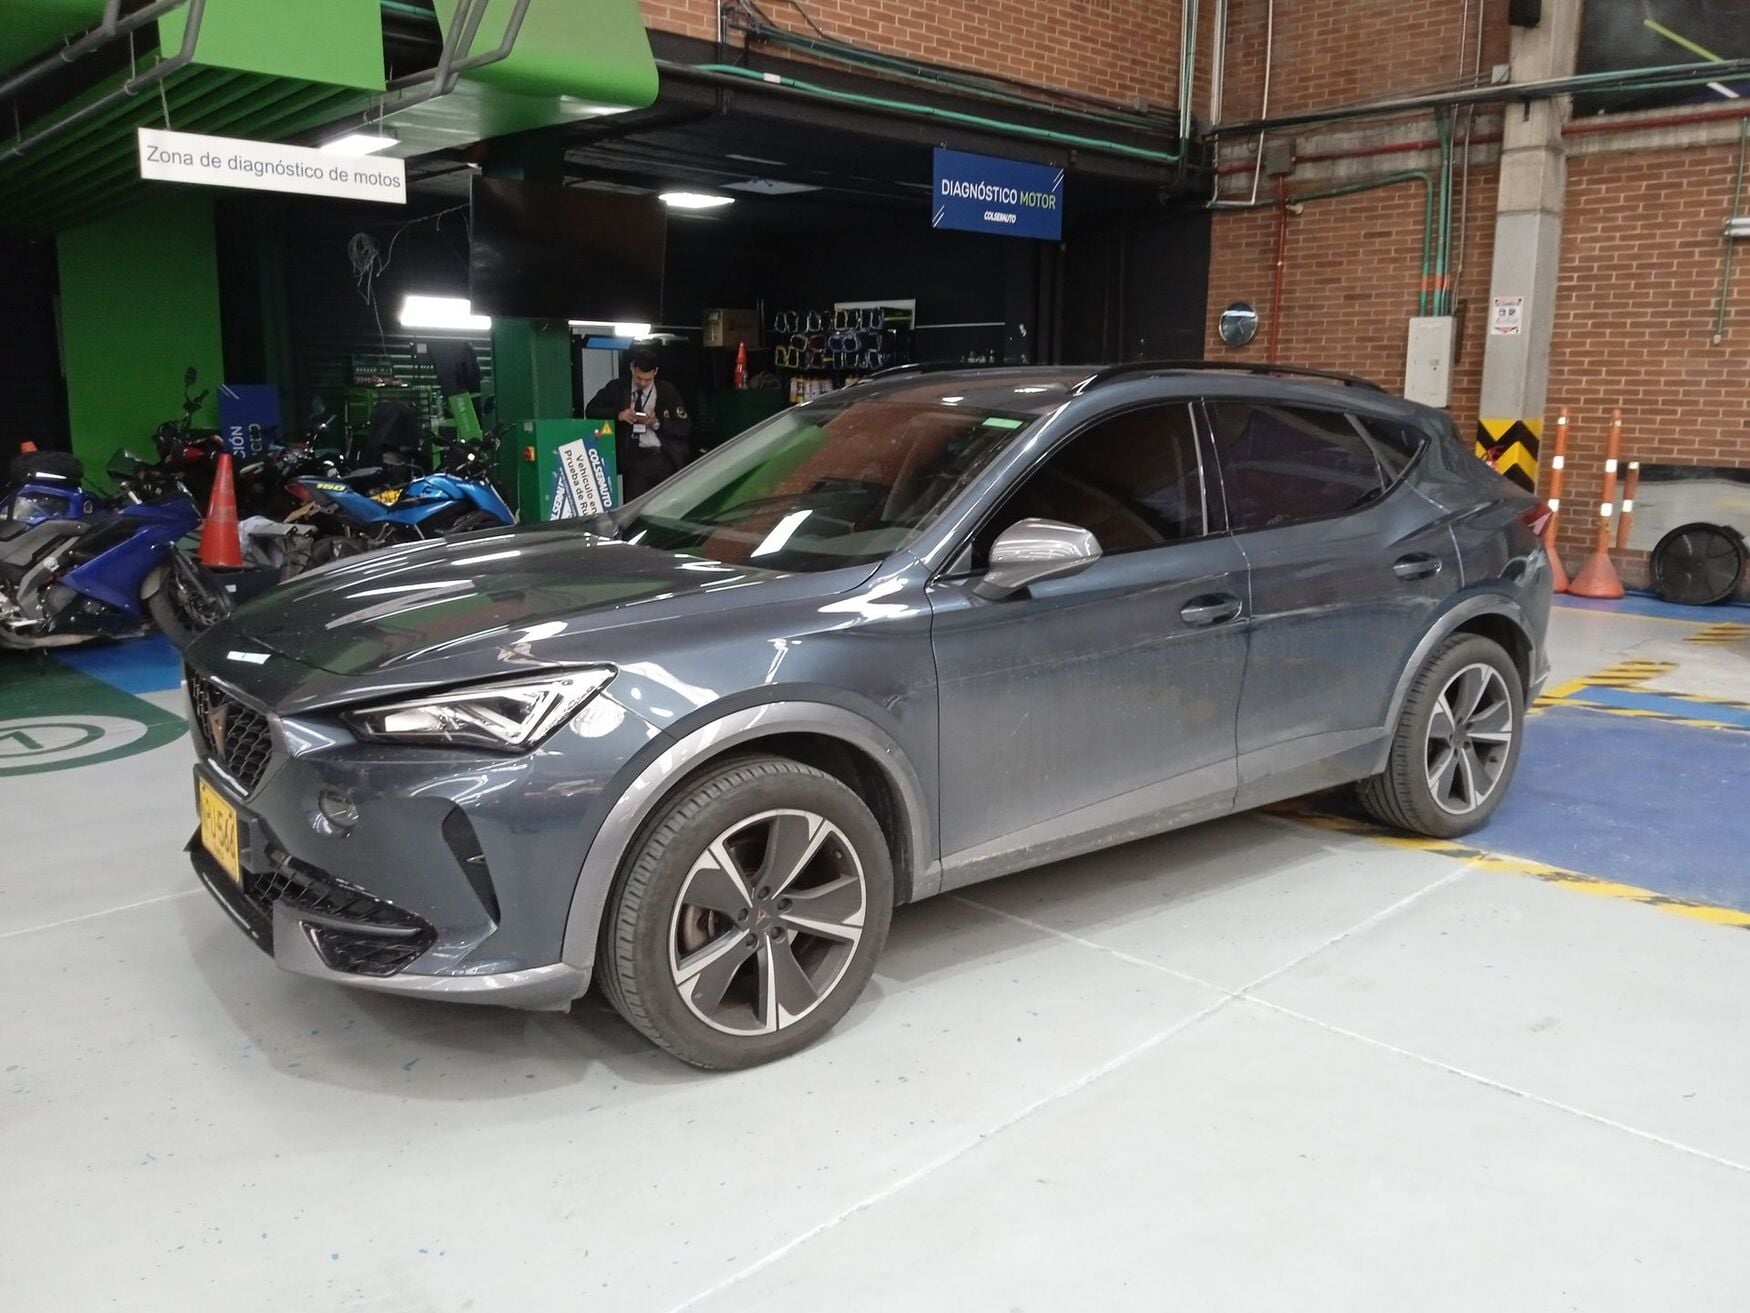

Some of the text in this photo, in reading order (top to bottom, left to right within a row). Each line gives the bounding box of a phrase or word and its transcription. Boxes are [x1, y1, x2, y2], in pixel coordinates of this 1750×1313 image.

[146, 145, 401, 188] Zona de diagnóstico de motos
[941, 179, 1056, 210] DIAGNÓSTICO MOTOR
[564, 449, 580, 487] Prueba
[575, 487, 584, 501] de
[588, 448, 613, 508] COLSERAUTO
